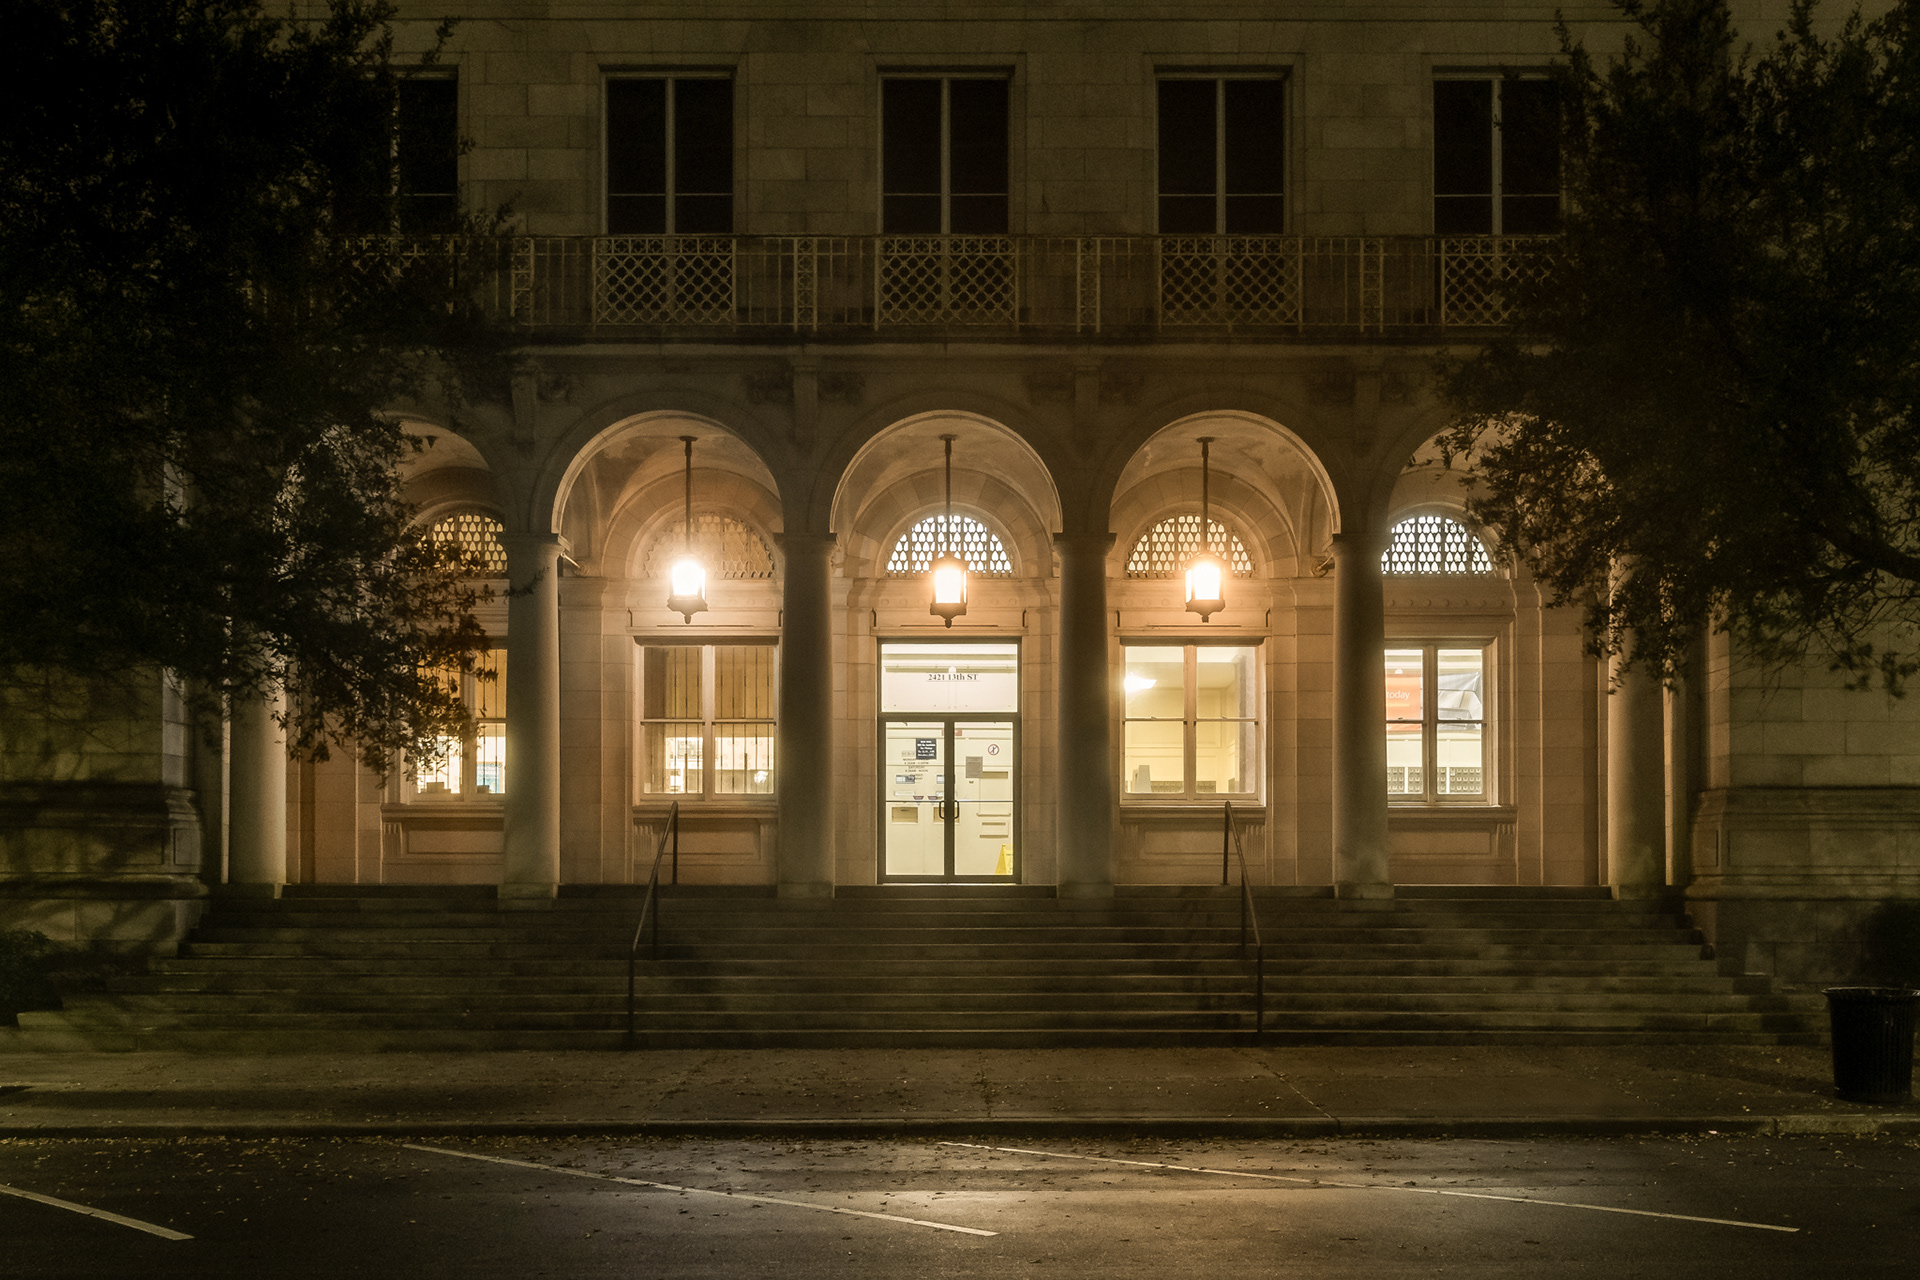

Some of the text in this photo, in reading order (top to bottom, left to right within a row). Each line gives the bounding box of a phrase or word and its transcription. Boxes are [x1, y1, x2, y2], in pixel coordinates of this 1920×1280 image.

[928, 673, 978, 681] 2421 13th ST
